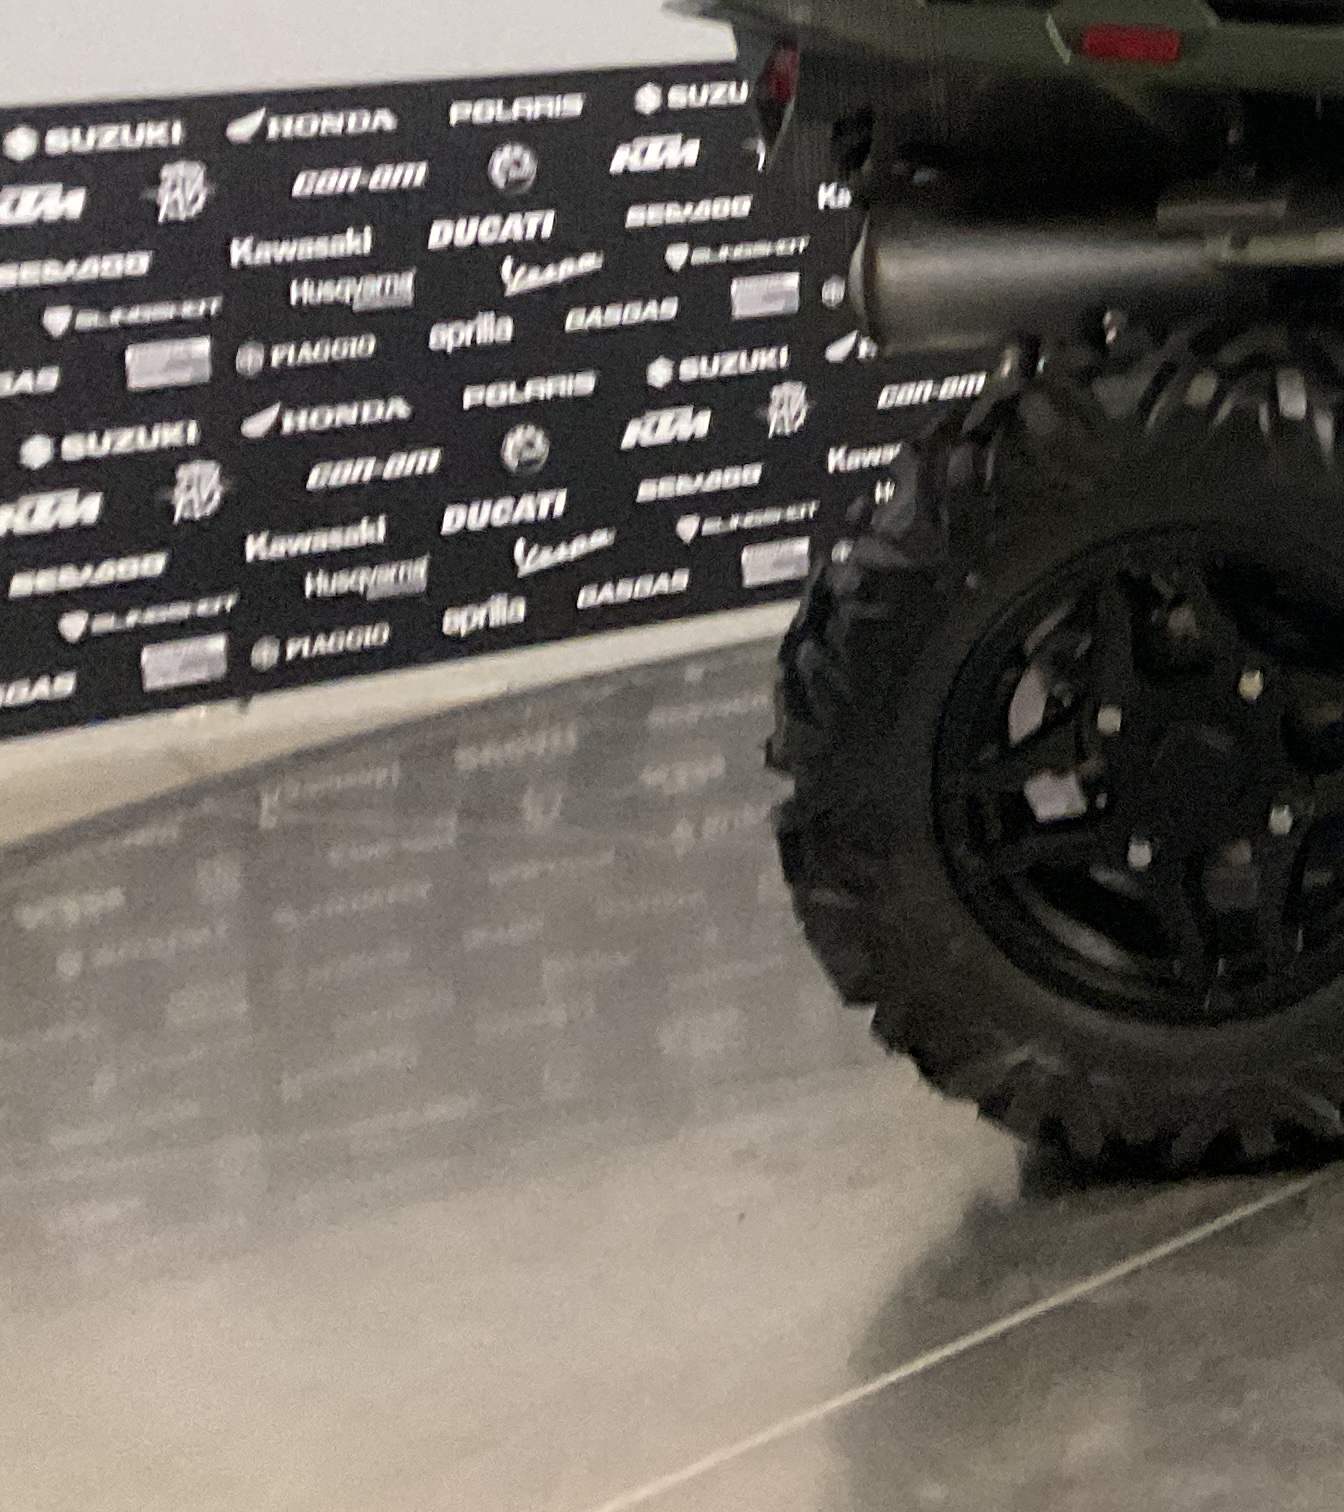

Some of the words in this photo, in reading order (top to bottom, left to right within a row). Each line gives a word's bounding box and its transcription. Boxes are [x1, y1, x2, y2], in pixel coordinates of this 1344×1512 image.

[262, 108, 396, 139] HONDA
[450, 94, 583, 126] POLARIS
[45, 120, 183, 154] SUZUKI
[610, 134, 700, 173] KTM
[230, 226, 372, 267] Kawasaki
[428, 210, 555, 249] DUCATI
[429, 312, 513, 353] aprilia
[565, 297, 678, 332] GASGAS
[679, 346, 792, 385] SUZUKI
[463, 372, 596, 409] POLARIS
[282, 397, 410, 434] HONDA
[621, 406, 711, 449] KTM
[61, 420, 200, 463] SUZUKI
[0, 489, 102, 536] KTM
[441, 489, 567, 534] DUCATI
[245, 515, 386, 562] Kawasaki
[577, 569, 689, 608] GASGAS
[443, 594, 525, 637] aprilia
